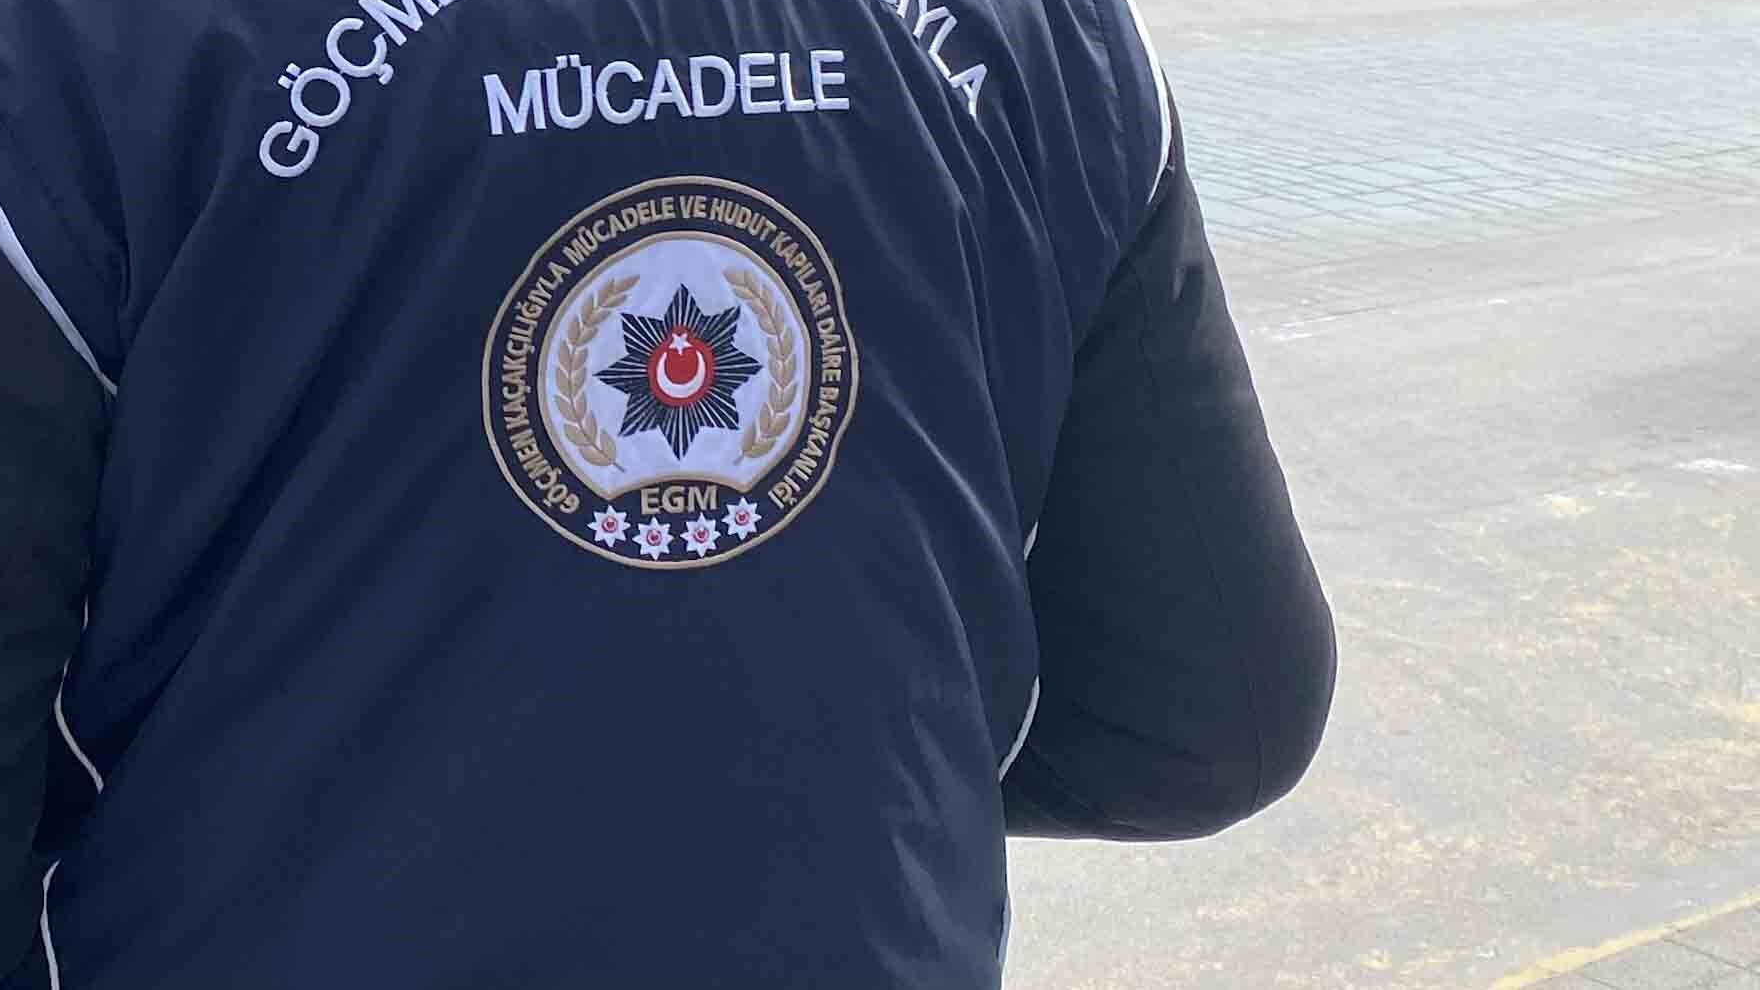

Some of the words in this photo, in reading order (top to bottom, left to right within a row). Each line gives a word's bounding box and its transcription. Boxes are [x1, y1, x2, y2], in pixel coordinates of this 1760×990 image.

[482, 49, 850, 136] MÜCADELE
[509, 428, 581, 515] GÖÇMEN
[562, 196, 676, 267] MÜCADELE
[679, 194, 708, 220] VE
[709, 197, 779, 242] HUDUT
[769, 230, 832, 319] KAPILARI
[814, 316, 846, 384] DAİRE
[640, 485, 718, 515] EGM
